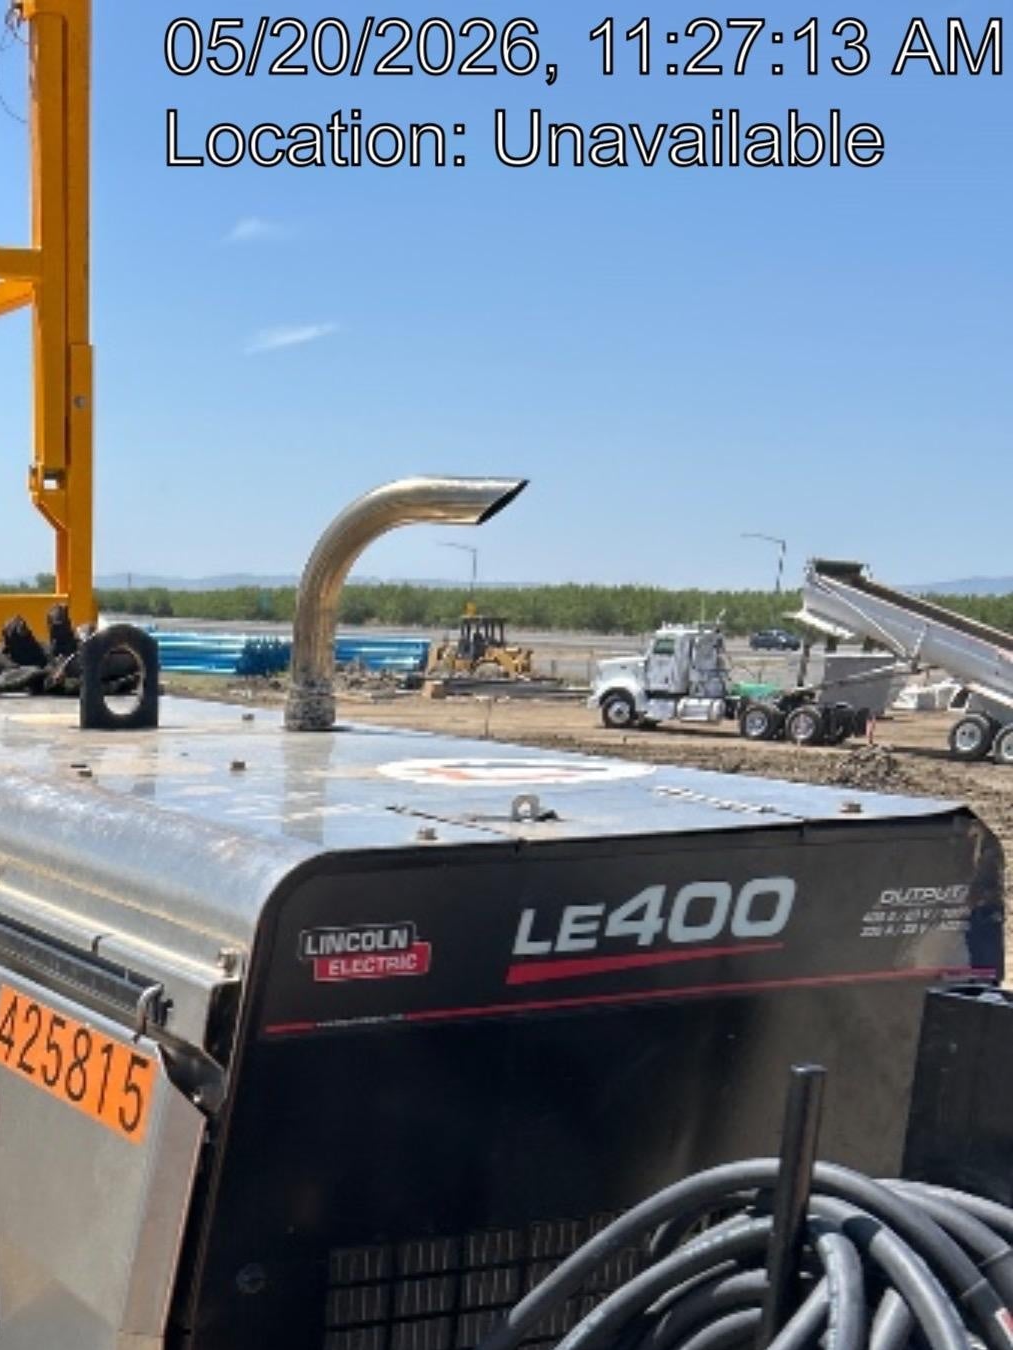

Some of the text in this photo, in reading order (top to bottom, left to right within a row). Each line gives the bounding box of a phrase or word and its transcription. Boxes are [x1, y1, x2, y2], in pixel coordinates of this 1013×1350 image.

[511, 875, 797, 956] LE400
[304, 928, 409, 956] LINCOLN
[328, 953, 418, 977] ELECTRIC
